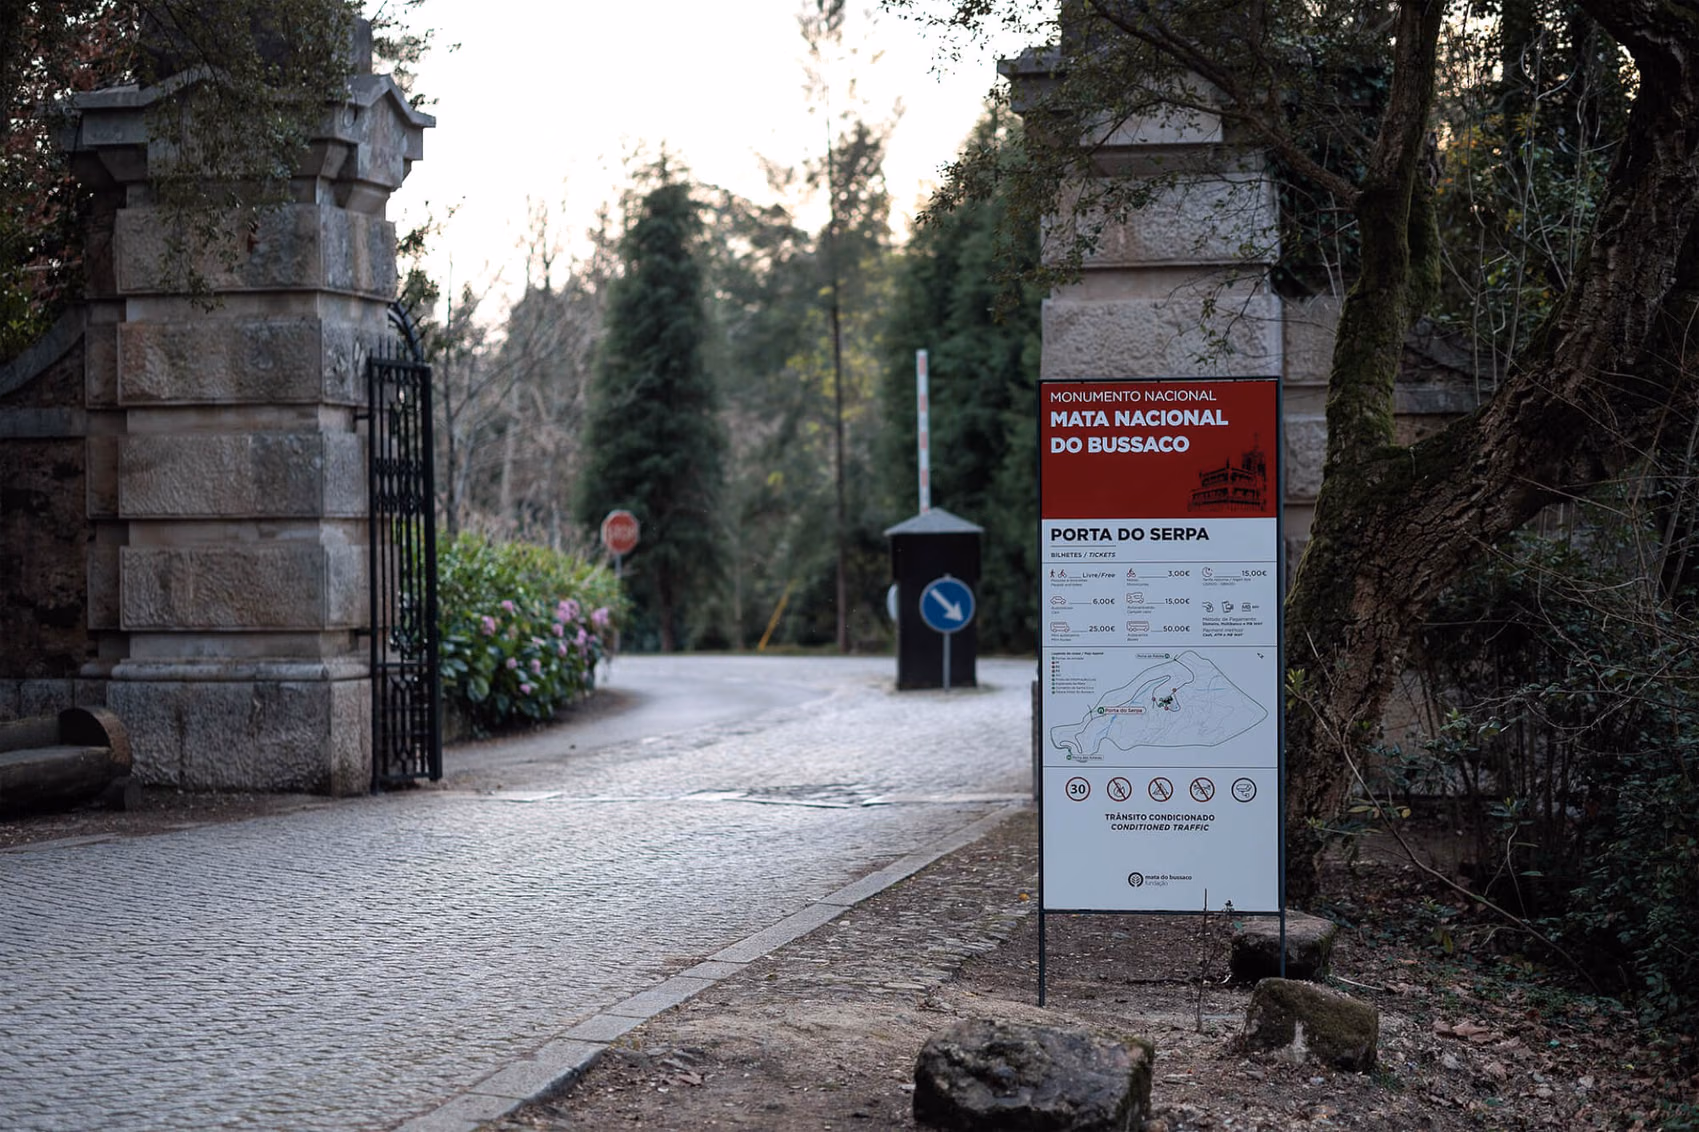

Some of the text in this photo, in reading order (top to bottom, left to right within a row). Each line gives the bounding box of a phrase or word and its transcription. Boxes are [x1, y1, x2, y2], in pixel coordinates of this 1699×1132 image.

[1050, 390, 1217, 402] MONUMENTO NACIONAL
[1050, 409, 1229, 427] MATA NACIONAL
[1050, 435, 1190, 453] DO BUSSACO
[1050, 527, 1209, 541] PORTA DO SERPA
[1167, 570, 1190, 578] 3,00€
[1088, 625, 1115, 633] 25,00€
[1163, 625, 1190, 633] 50,00€
[1070, 784, 1086, 795] 30
[1105, 812, 1215, 822] TRÂNSITO CONDICIONADO
[1111, 823, 1171, 831] CONDITIONED
